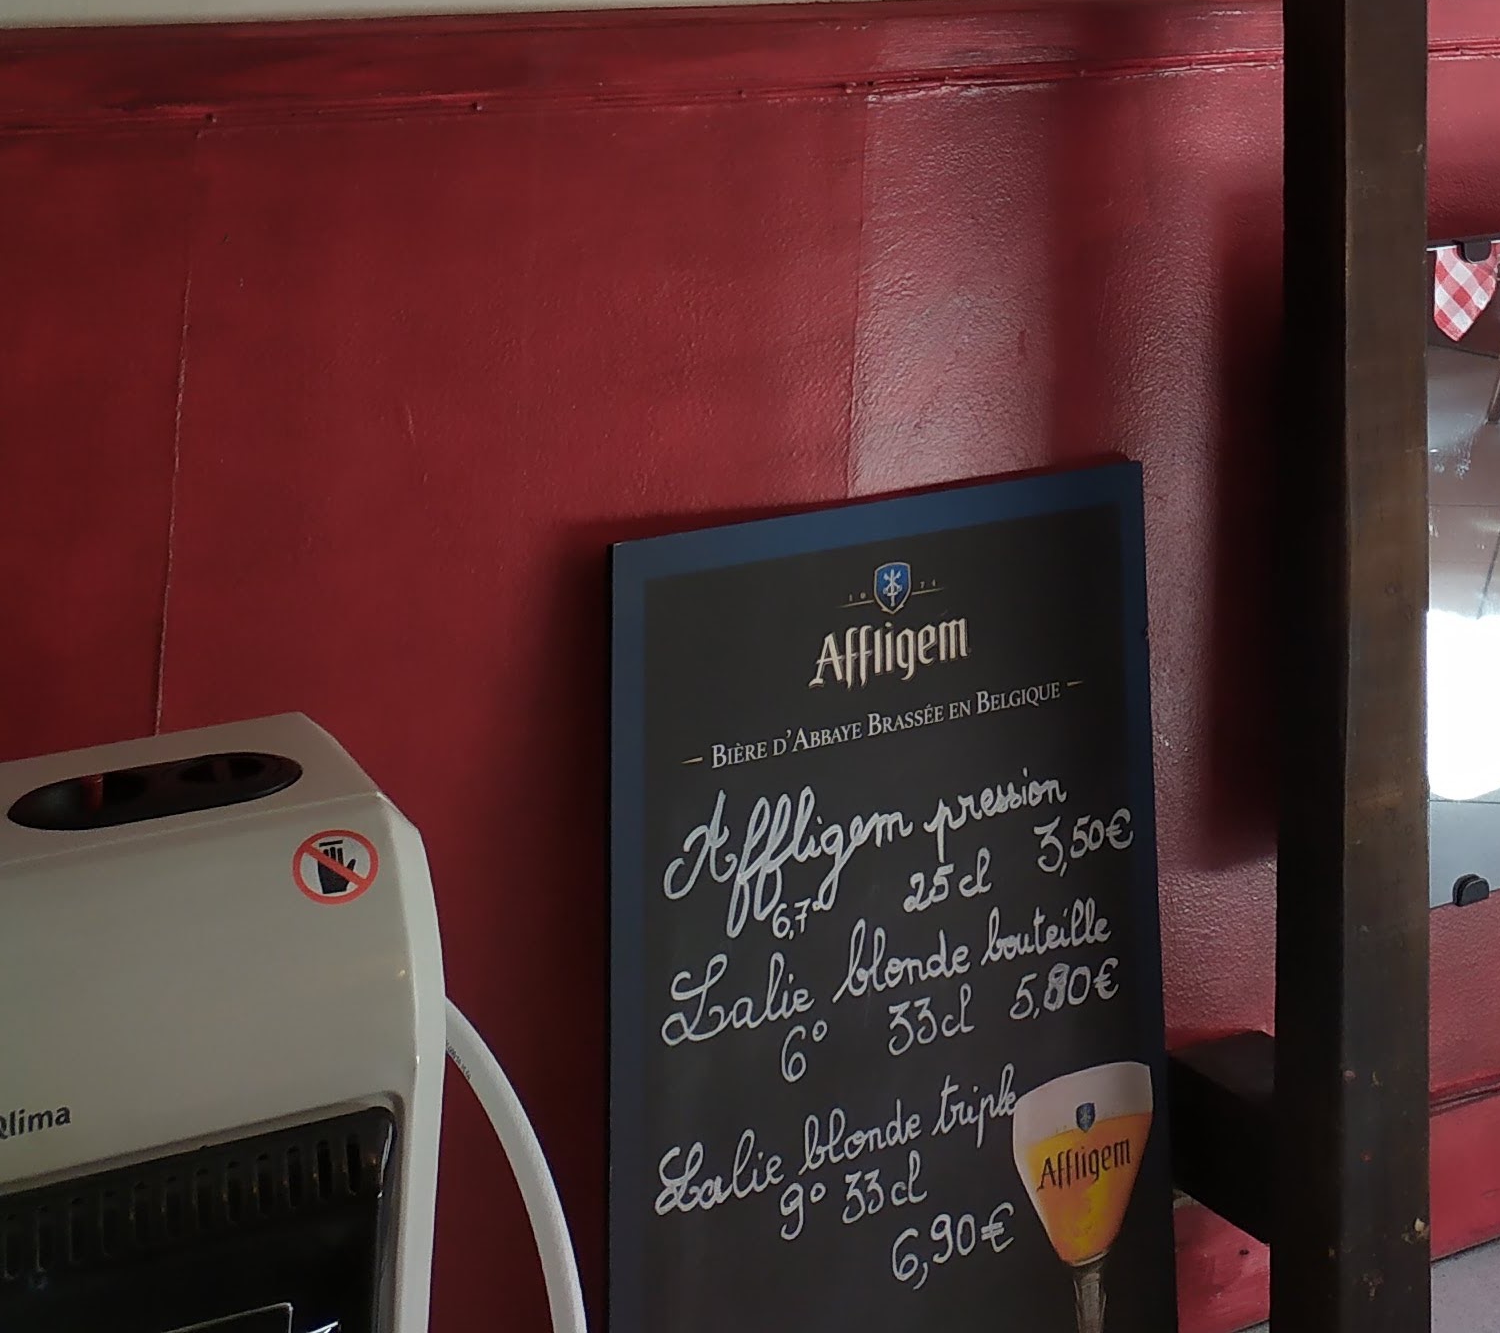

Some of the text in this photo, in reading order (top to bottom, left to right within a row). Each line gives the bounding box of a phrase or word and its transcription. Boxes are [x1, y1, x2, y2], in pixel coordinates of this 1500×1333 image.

[808, 614, 972, 690] Affligem
[662, 767, 1067, 939] Affligem pression
[1033, 807, 1135, 875] 3,50€
[660, 905, 1113, 1048] Lalie blonde bouteille
[779, 957, 1120, 1084] 6° 5,80€
[0, 1103, 72, 1136] lima
[653, 1062, 1018, 1217] Lalie blonde triple
[1036, 1134, 1132, 1193] Affligem
[890, 1203, 1016, 1292] 6,90€
